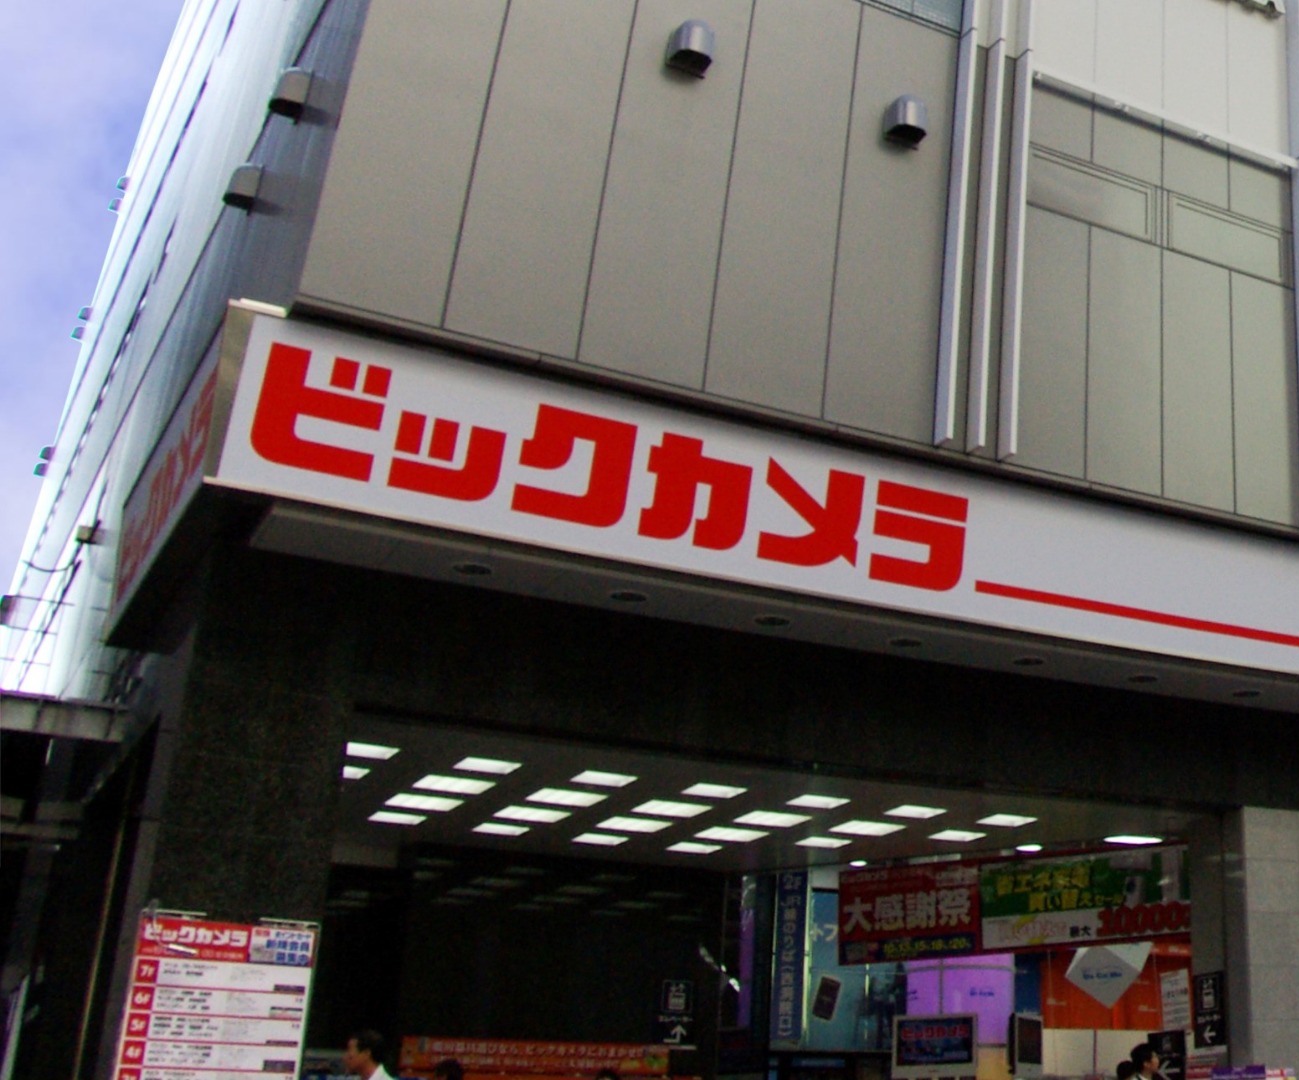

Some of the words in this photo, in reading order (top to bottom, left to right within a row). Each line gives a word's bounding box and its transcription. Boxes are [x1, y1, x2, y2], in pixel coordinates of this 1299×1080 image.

[250, 341, 969, 592] ビックカメラ
[842, 888, 972, 935] 大感謝祭
[144, 923, 249, 948] ビックカメラ
[140, 962, 155, 977] 7F
[134, 991, 150, 1005] 6F
[130, 1018, 146, 1032] 5F
[125, 1045, 141, 1058] 4F
